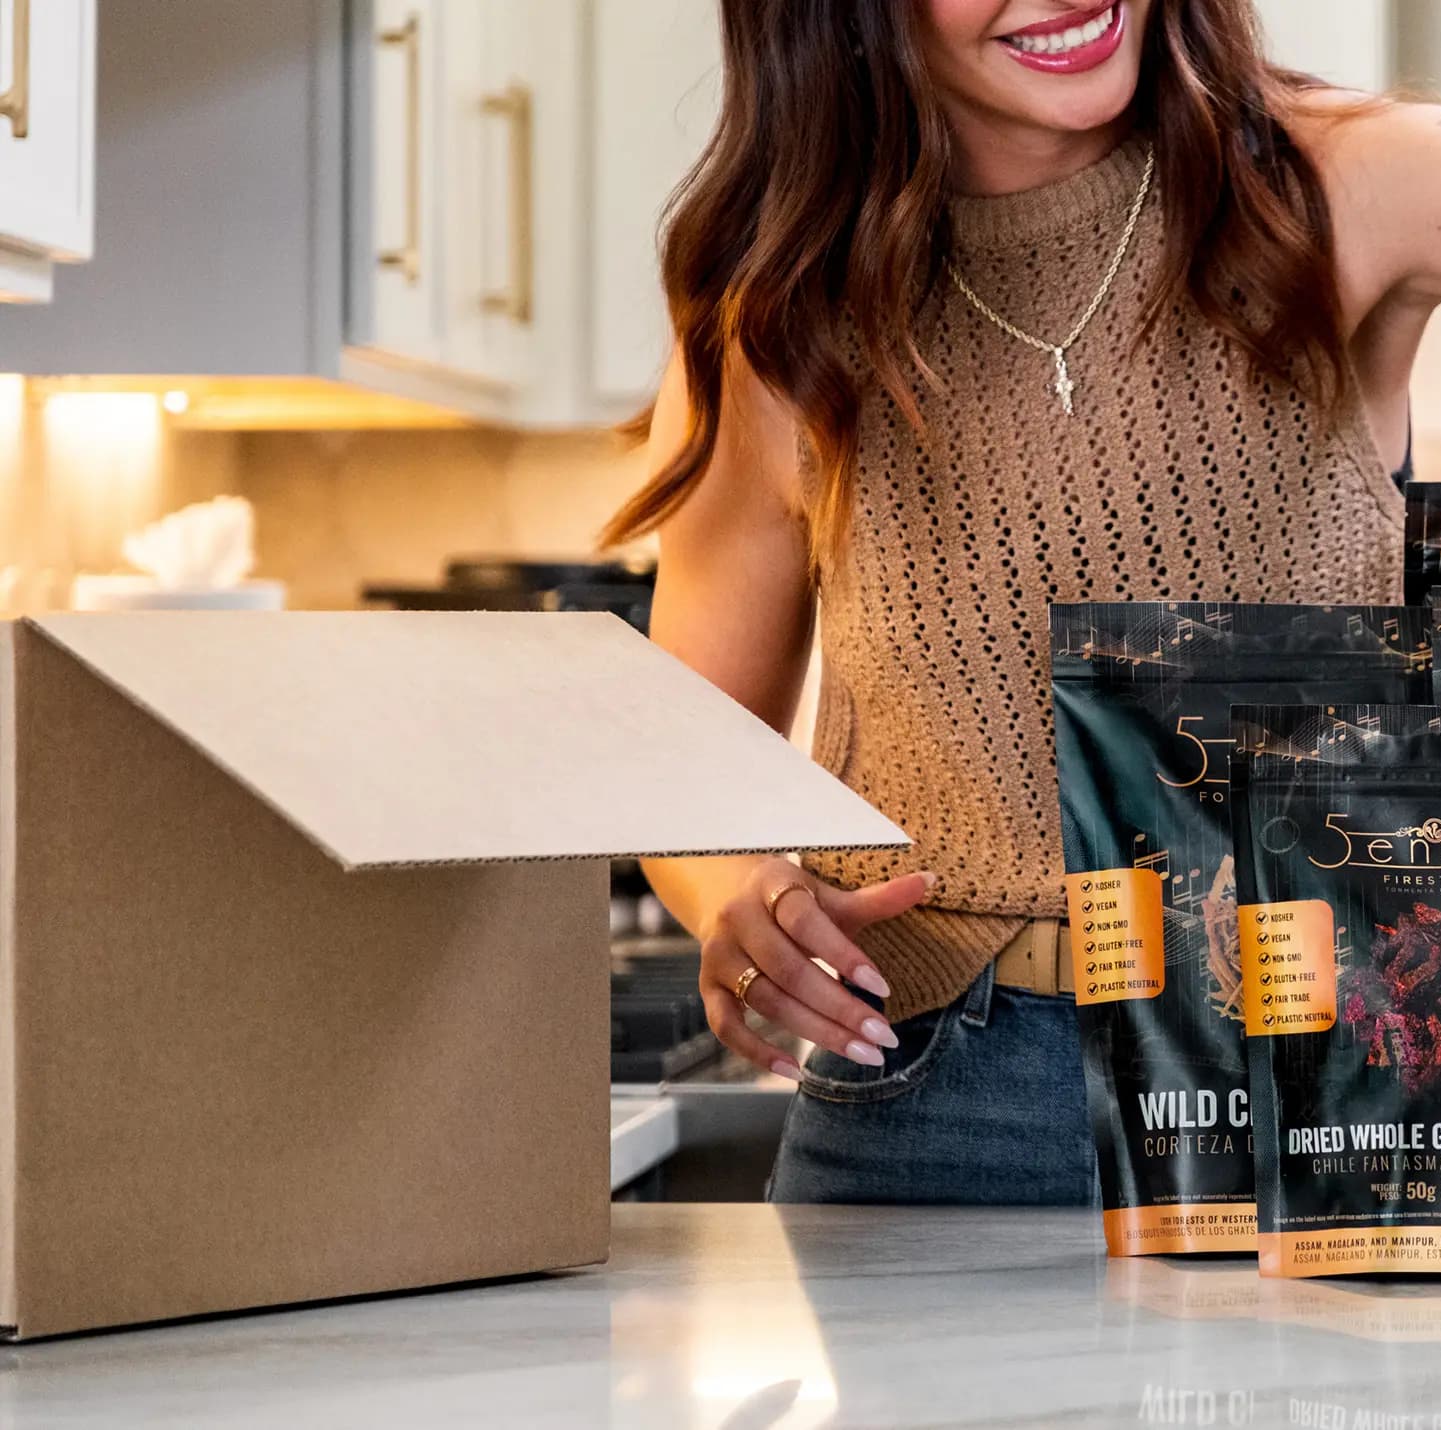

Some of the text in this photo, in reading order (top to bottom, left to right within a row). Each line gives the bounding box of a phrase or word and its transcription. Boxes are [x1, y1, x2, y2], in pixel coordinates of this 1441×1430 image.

[1095, 880, 1121, 891] KOSHER
[1096, 901, 1117, 911] VEGAN
[1271, 913, 1294, 923] KOSHER
[1097, 920, 1129, 931] NON-GMO
[1271, 934, 1291, 943] VEGAN
[1097, 939, 1144, 952] GLUTEN-FREE
[1272, 953, 1302, 964] NON-GMO
[1099, 959, 1136, 973] FAIR TRADE
[1274, 972, 1316, 984] GLUTEN-FREE
[1100, 979, 1160, 993] PLASTIC NEUTRAL
[1275, 993, 1311, 1003] FAIR TRADE
[1277, 1011, 1333, 1024] PLASTIC NEUTRAL
[1138, 1089, 1254, 1131] WILD C
[1289, 1126, 1345, 1155] DRIED
[1350, 1123, 1425, 1150] WHOLE
[1144, 1134, 1234, 1158] CORTEZA
[1313, 1157, 1356, 1175] CHILE
[1406, 1181, 1437, 1202] 50g
[1208, 1215, 1218, 1224] OF
[1195, 1226, 1206, 1236] DE
[1209, 1226, 1225, 1236] LOS
[1227, 1225, 1256, 1235] GHATS
[1295, 1241, 1325, 1251] ASSAM,
[1327, 1238, 1368, 1249] NAGALAND,
[1370, 1237, 1388, 1246] AND
[1391, 1236, 1438, 1247] MANIPUR,
[1325, 1249, 1365, 1262] NAGALAND
[1368, 1250, 1373, 1259] Y
[1376, 1249, 1423, 1260] MANIPUR,
